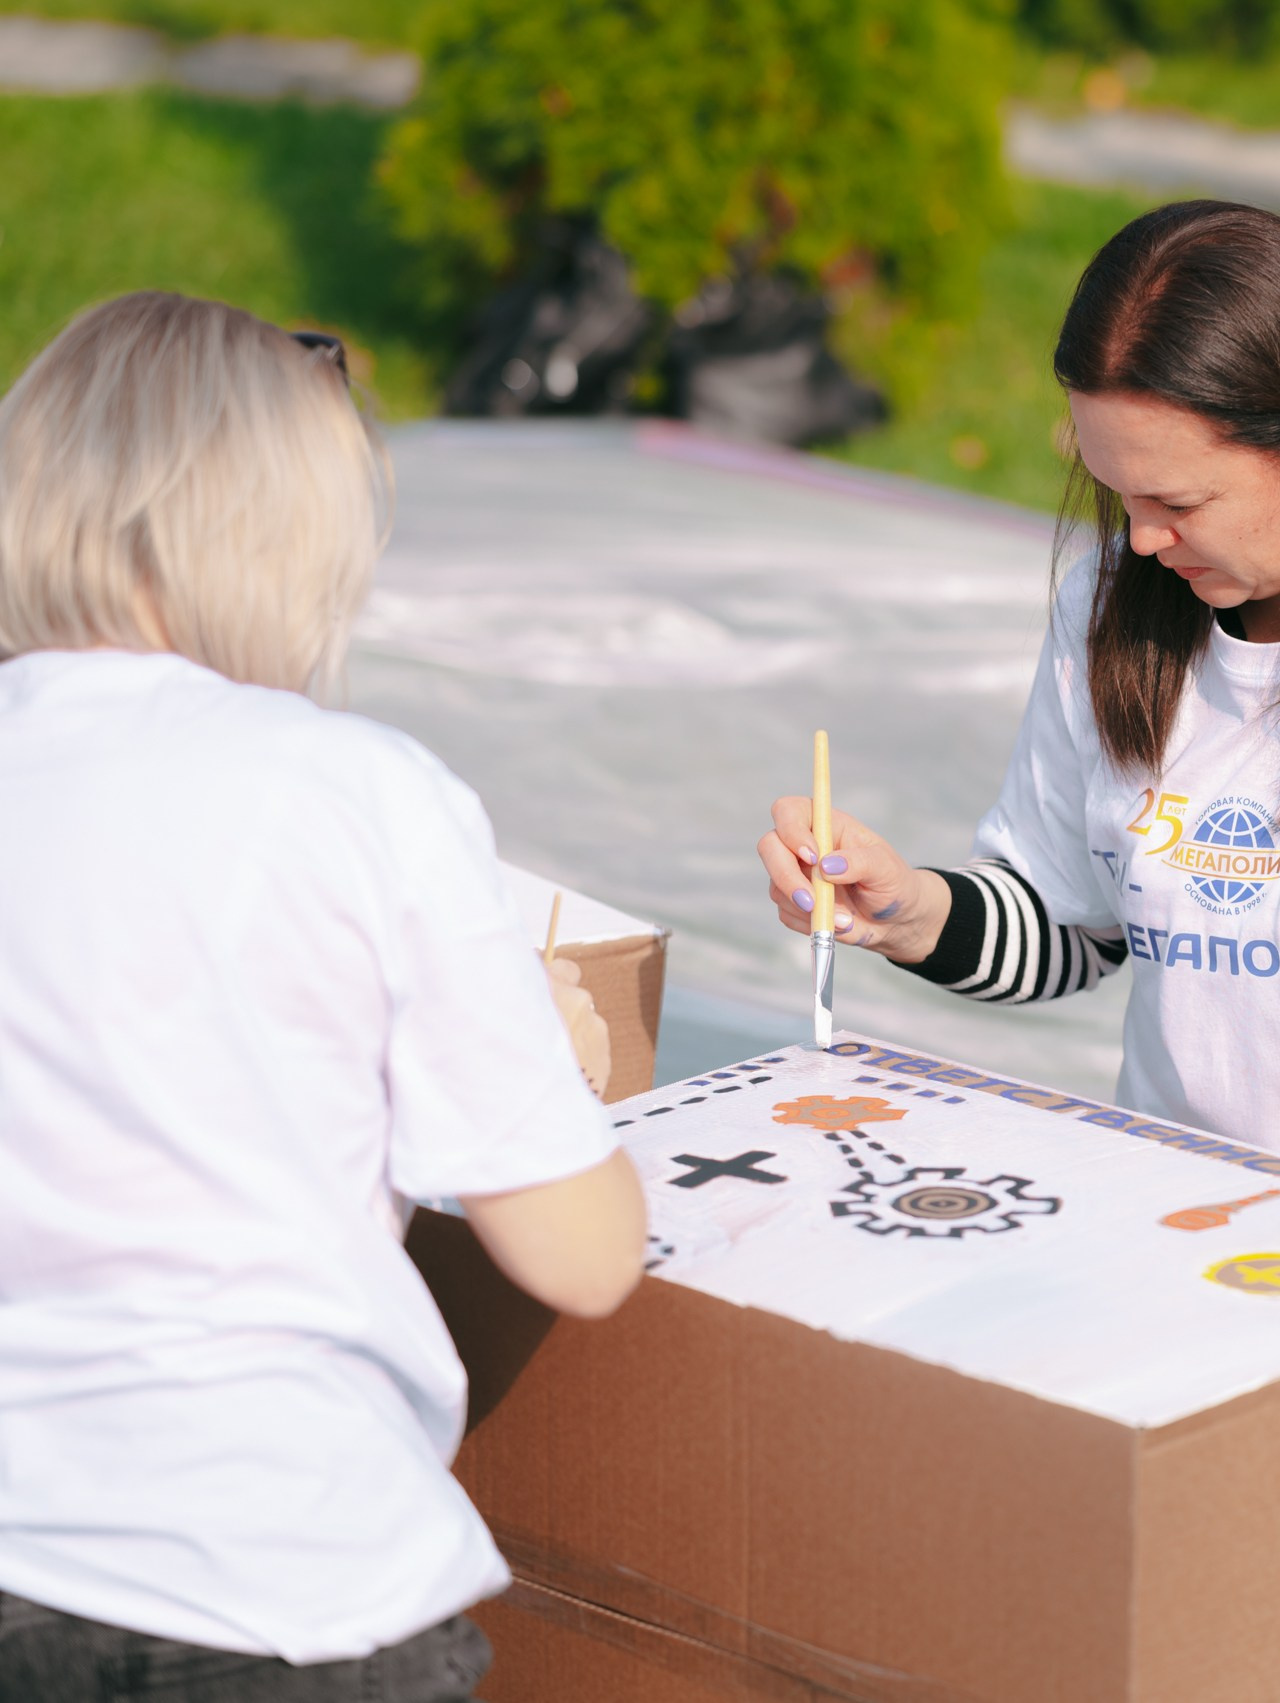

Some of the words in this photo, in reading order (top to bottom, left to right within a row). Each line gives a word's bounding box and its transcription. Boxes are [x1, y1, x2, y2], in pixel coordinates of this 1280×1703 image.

[1126, 788, 1189, 855] 25
[1236, 797, 1280, 834] КОМПАНИЯ
[1184, 883, 1232, 916] ОСНОВАНА
[1242, 896, 1261, 912] 1998
